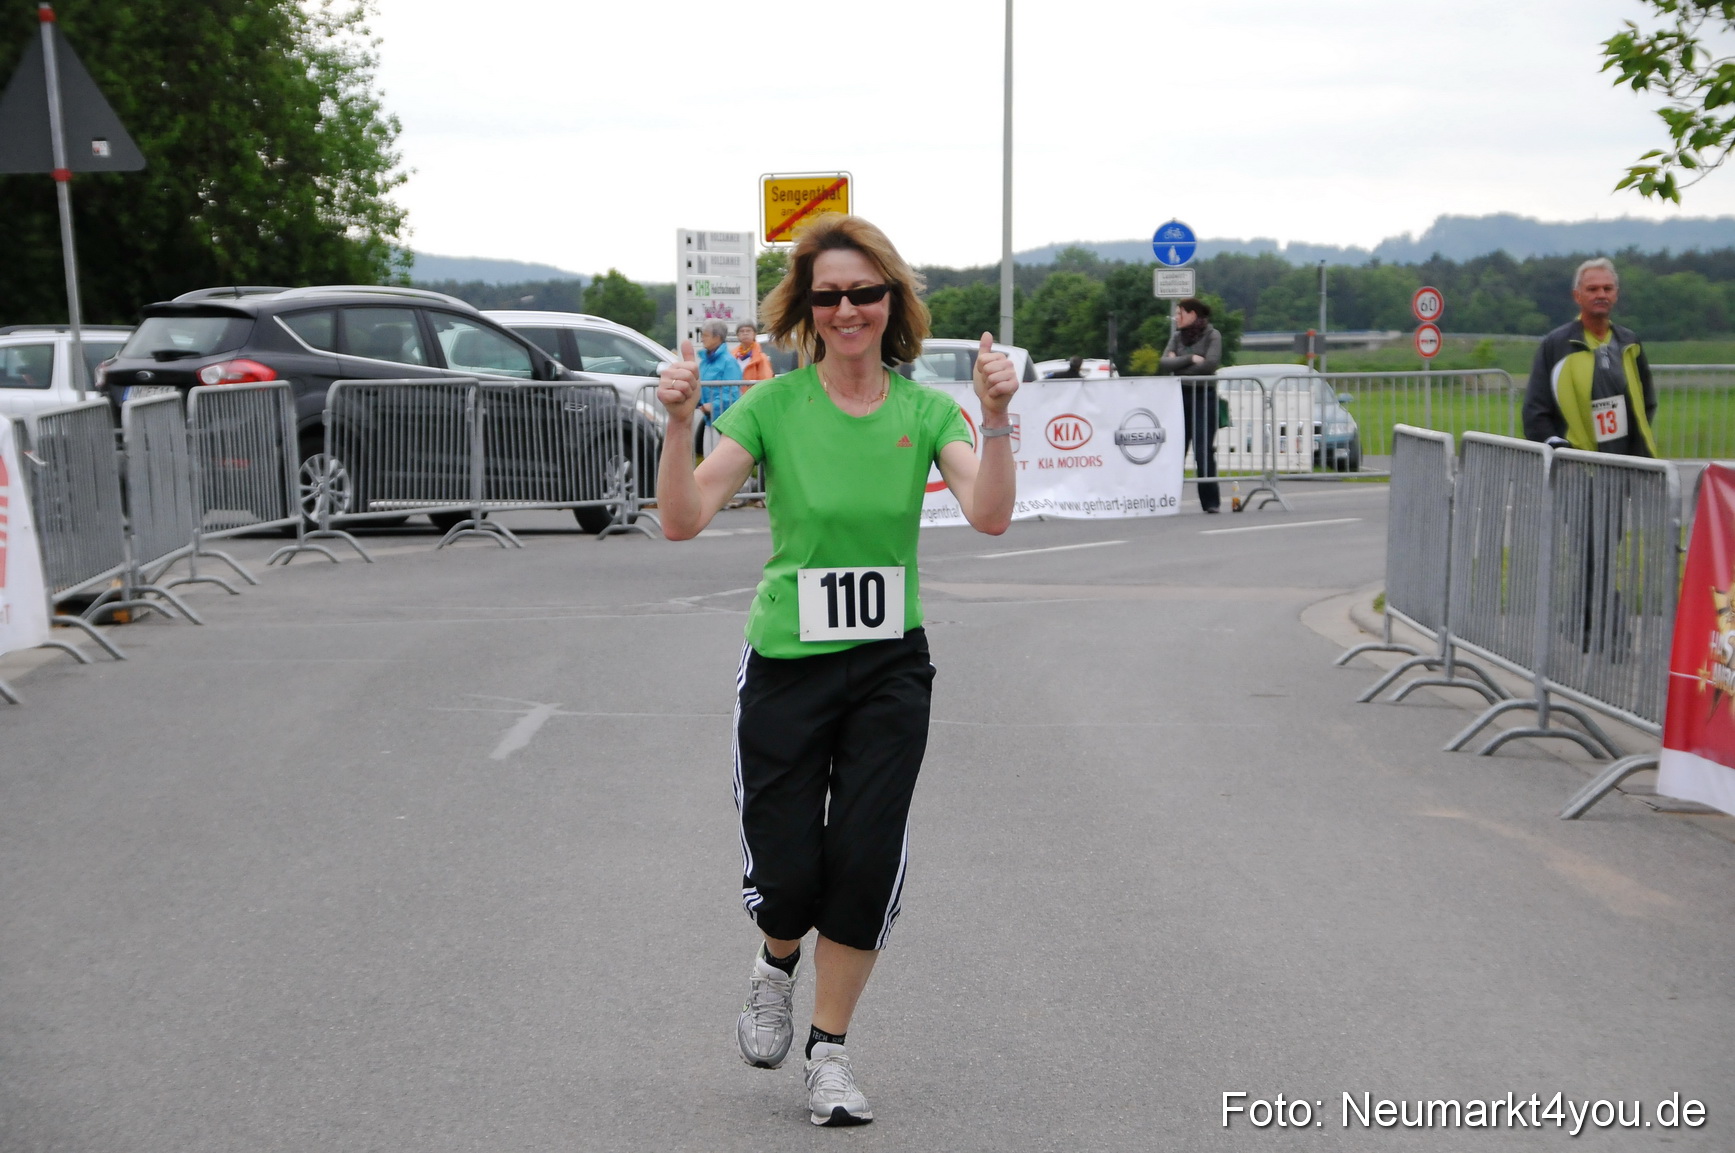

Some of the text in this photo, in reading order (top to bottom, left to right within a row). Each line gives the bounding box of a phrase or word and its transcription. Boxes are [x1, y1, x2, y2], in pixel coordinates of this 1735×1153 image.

[772, 184, 841, 206] Sengenthal
[1421, 296, 1437, 311] 60
[1596, 410, 1618, 435] 13
[1054, 422, 1084, 442] KIA
[1120, 431, 1161, 442] NISSAN
[1038, 457, 1055, 469] KIA
[1057, 455, 1103, 469] MOTORS
[921, 504, 961, 522] ngenthal
[820, 571, 886, 628] 110
[812, 1030, 828, 1042] TECH
